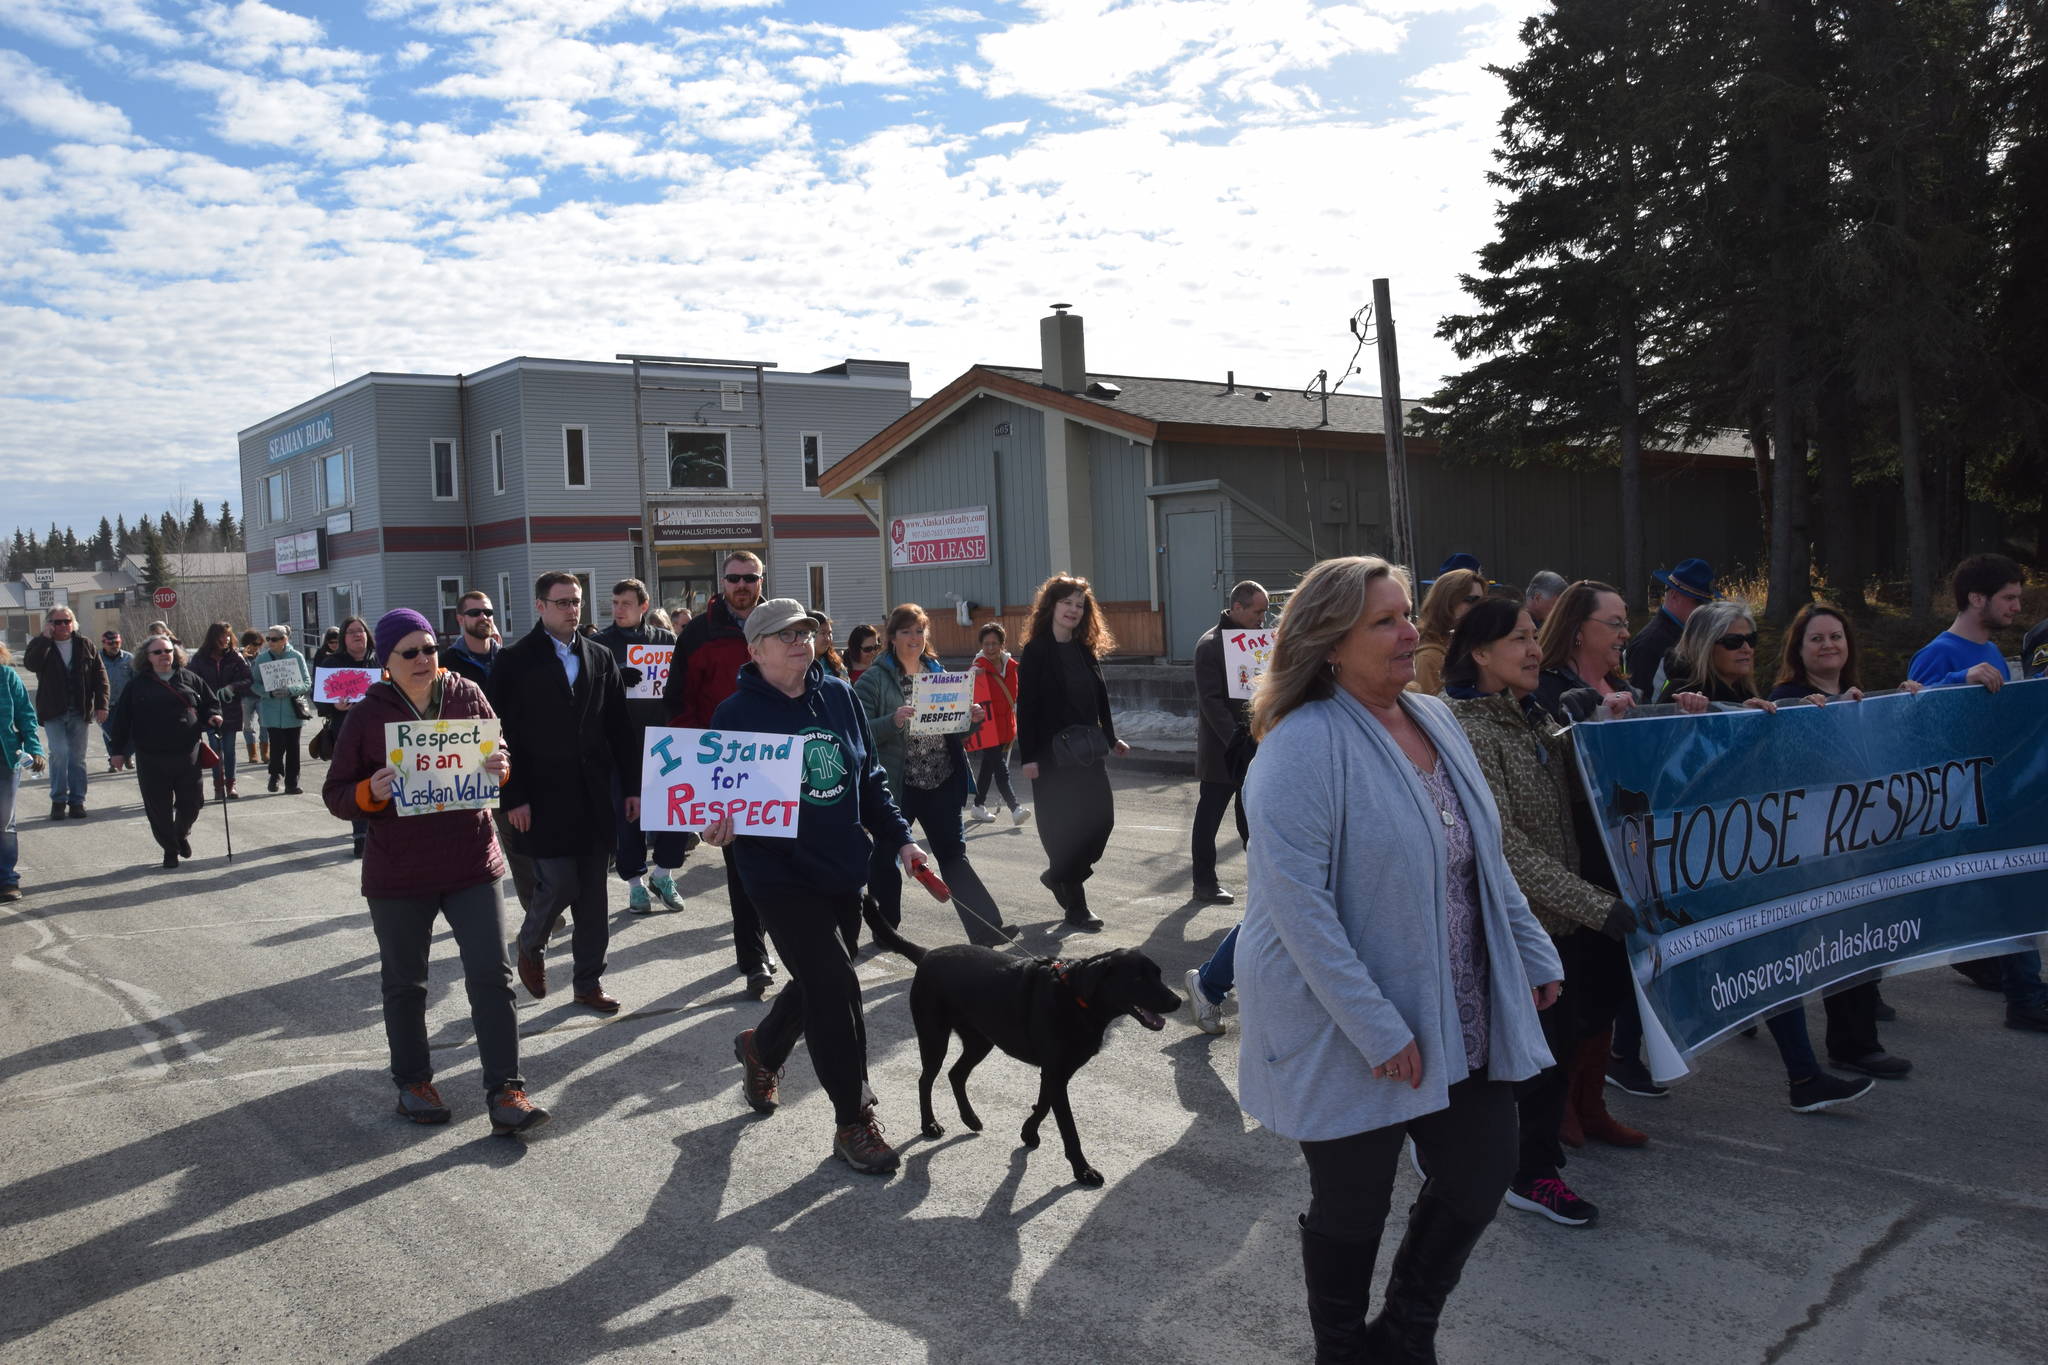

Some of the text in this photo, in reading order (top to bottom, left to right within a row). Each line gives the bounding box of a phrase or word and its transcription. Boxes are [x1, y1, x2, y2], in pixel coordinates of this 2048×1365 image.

[269, 417, 333, 460] SEAMAN BLDG.
[687, 509, 702, 518] Full
[704, 508, 734, 518] Kitchen
[735, 508, 757, 517] Suites
[909, 539, 985, 563] FOR LEASE
[154, 593, 176, 604] STOP
[930, 692, 959, 703] TEACH
[397, 724, 481, 752] Respect
[816, 732, 834, 742] DOT
[416, 753, 463, 771] is an
[650, 731, 794, 777] I Stand
[711, 766, 749, 790] for
[808, 784, 845, 798] ALASKA
[667, 783, 798, 827] RESPECT
[1621, 756, 1995, 901] CHOOSE RESPECT
[1693, 920, 1735, 948] ENDING
[1737, 917, 1758, 933] THE
[1760, 899, 1808, 926] EPIDEMIC
[1810, 895, 1824, 911] OF
[1826, 881, 1876, 907] DOMESTIC
[1877, 870, 1926, 893] VIOLENCE
[1928, 865, 1951, 882] AND
[1954, 858, 2000, 876] SEXUAL
[1710, 917, 1921, 1011] chooserespect.alaska.gov
